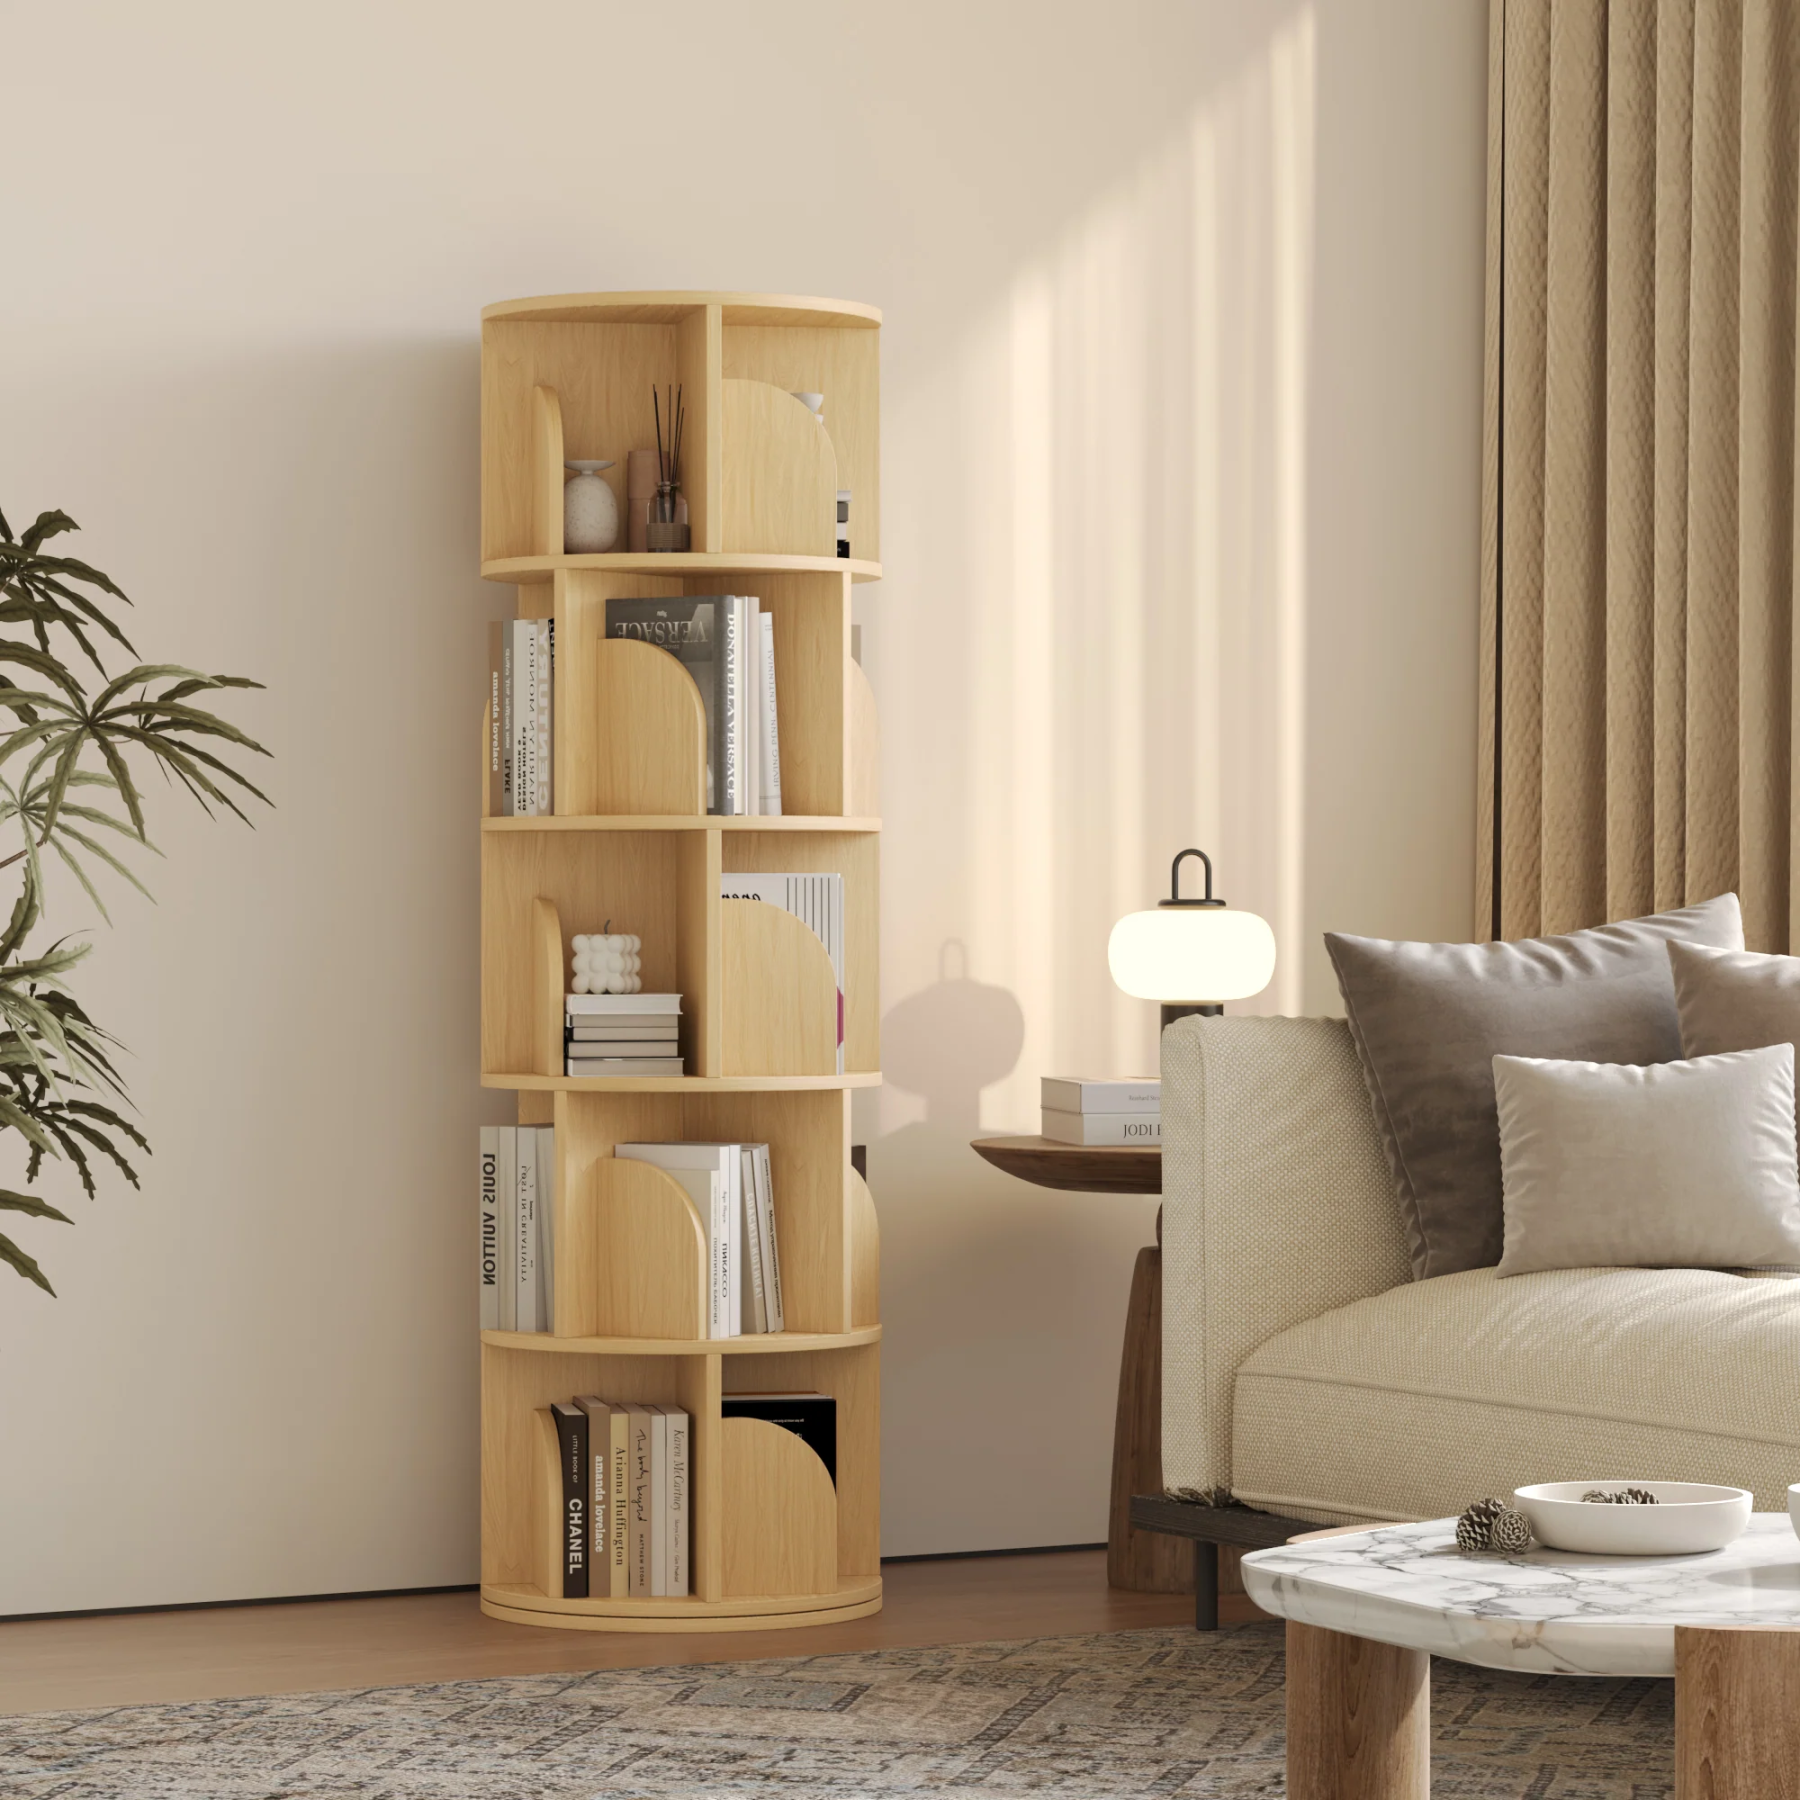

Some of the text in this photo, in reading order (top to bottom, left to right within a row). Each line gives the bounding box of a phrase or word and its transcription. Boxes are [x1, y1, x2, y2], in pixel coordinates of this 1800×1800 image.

[615, 620, 708, 643] VERSACE
[727, 613, 735, 799] DONATELLA VERSACE
[767, 648, 776, 712] CENTENNIAL
[771, 749, 779, 787] IRVING
[1123, 1124, 1152, 1139] JODI
[636, 1428, 646, 1452] The
[670, 1429, 684, 1512] Karen McCartney
[569, 1498, 582, 1574] CHANEL
[595, 1455, 605, 1553] amanda lovelace
[612, 1447, 626, 1566] Arianna Huffington
